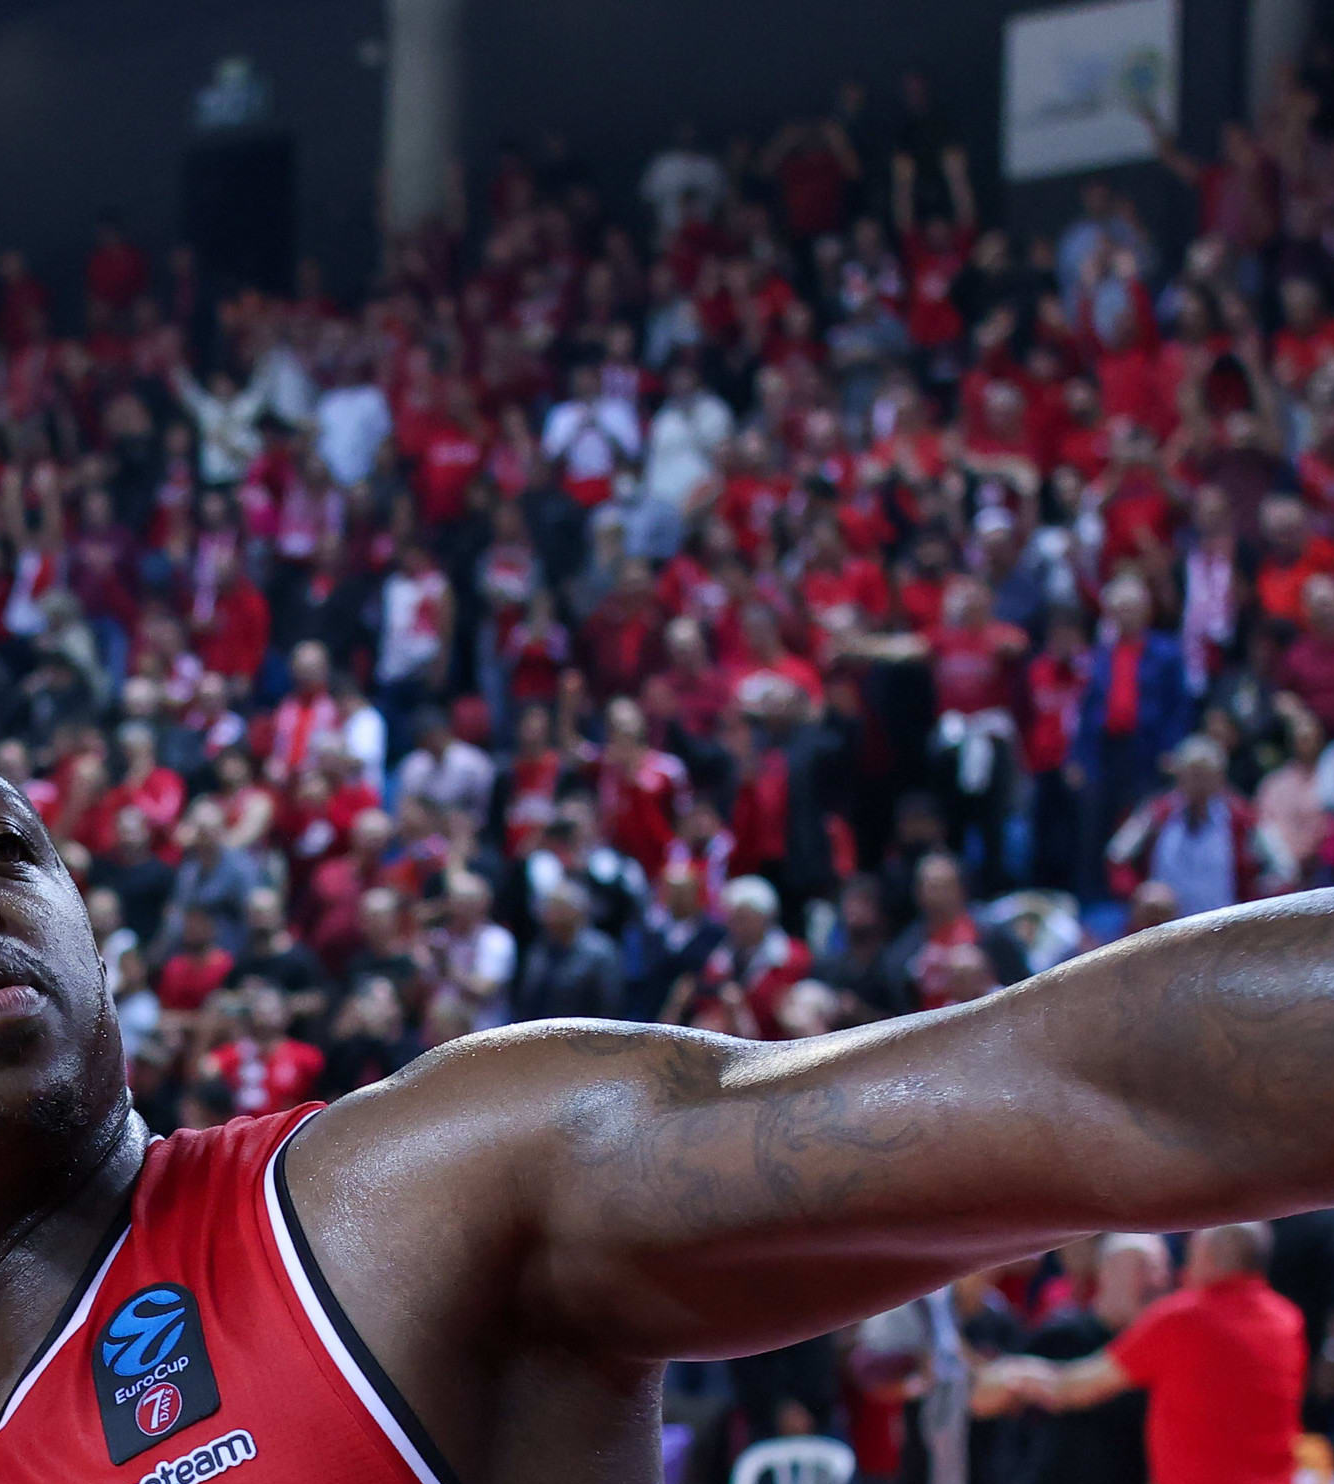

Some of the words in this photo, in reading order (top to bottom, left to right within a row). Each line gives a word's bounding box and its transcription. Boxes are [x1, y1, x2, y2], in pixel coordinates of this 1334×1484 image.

[114, 1355, 190, 1405] EuroCup
[142, 1388, 165, 1429] 7
[159, 1388, 174, 1423] DAYS
